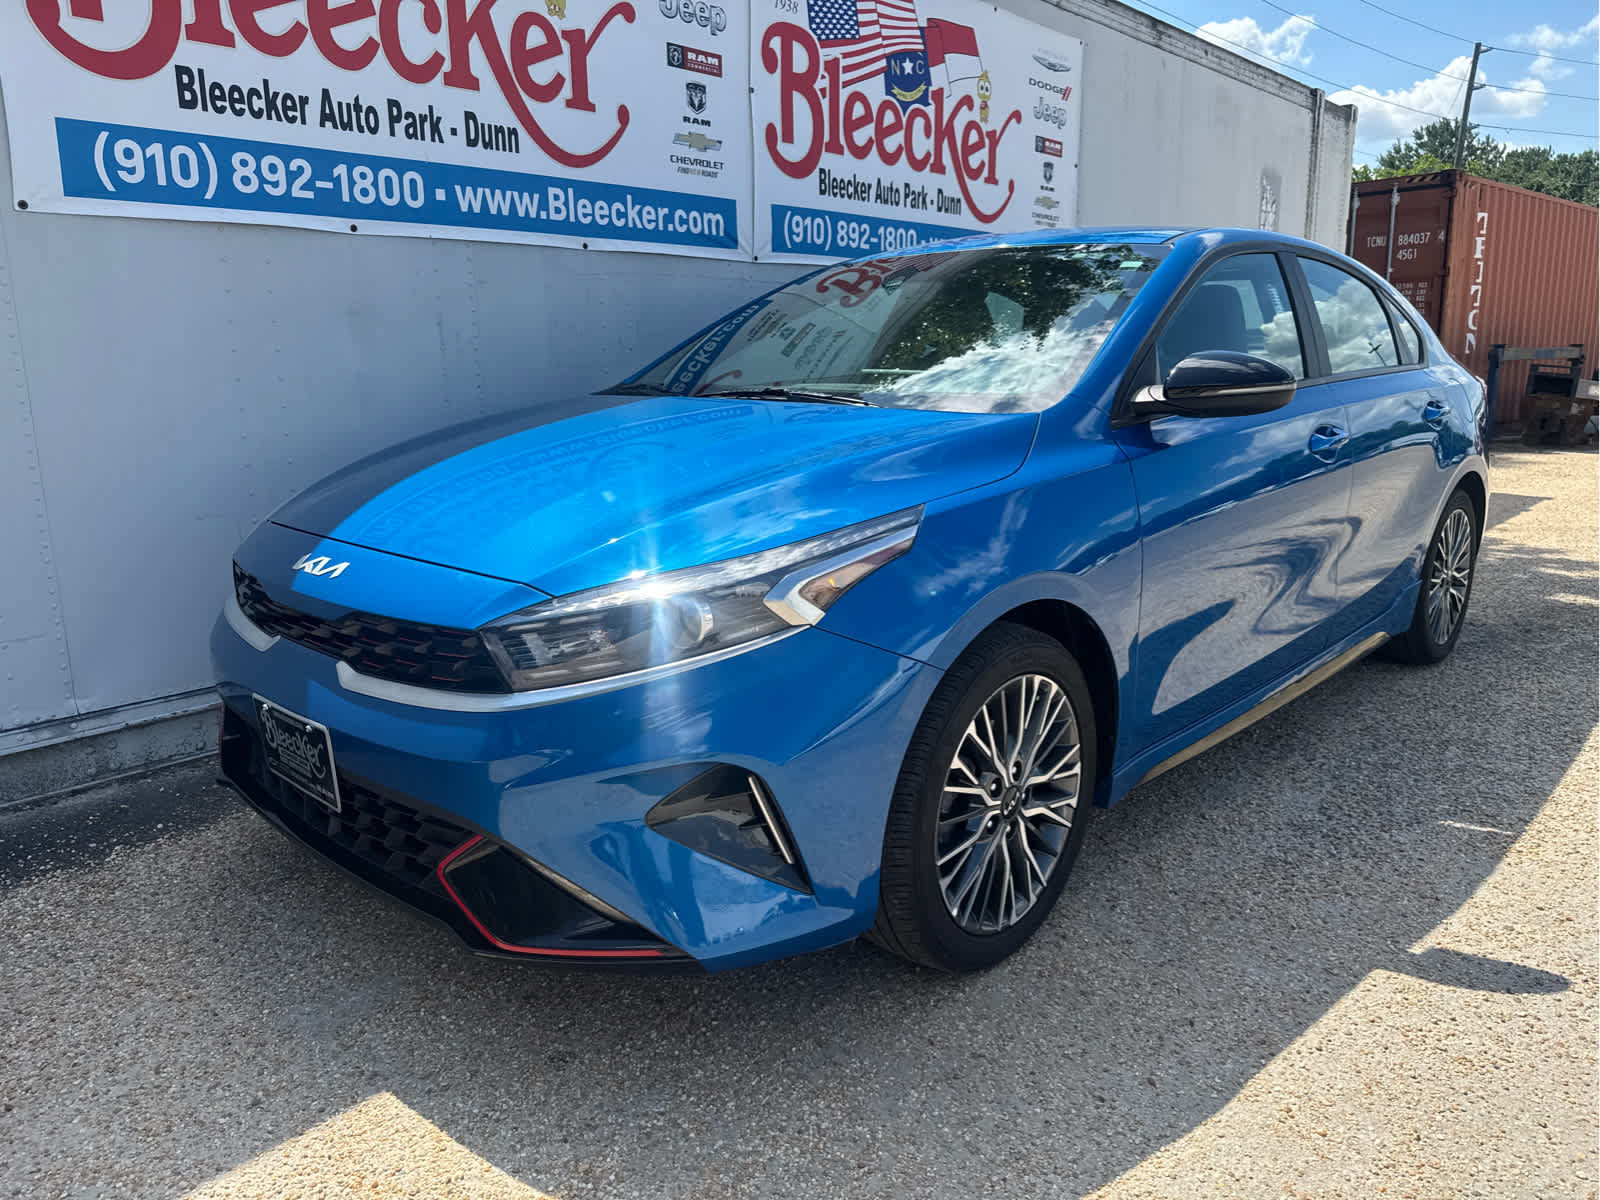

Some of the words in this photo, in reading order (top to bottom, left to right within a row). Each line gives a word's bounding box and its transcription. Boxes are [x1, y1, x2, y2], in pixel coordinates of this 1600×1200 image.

[659, 0, 727, 36] Jeep
[775, 0, 799, 14] 1938
[687, 52, 719, 66] RAM
[1029, 77, 1065, 96] DODGE
[175, 64, 309, 126] Bleecker
[319, 88, 380, 135] Auto
[387, 98, 445, 144] Park
[464, 110, 520, 154] Dunn
[682, 116, 712, 128] RAM
[762, 22, 1022, 224] Bleecker
[1033, 96, 1067, 130] Jeep
[670, 154, 725, 170] CHEVROLET
[94, 131, 218, 199] (910)
[231, 152, 424, 209] 892-1800
[454, 184, 725, 237] www.Bleecker.com
[819, 168, 872, 203] Bleecker
[874, 177, 900, 207] Auto
[904, 182, 928, 211] Park
[936, 188, 962, 216] Dunn
[784, 211, 832, 251] (910)
[836, 220, 917, 251] 892-1800
[1398, 232, 1431, 246] 884037
[1438, 229, 1445, 241] 4
